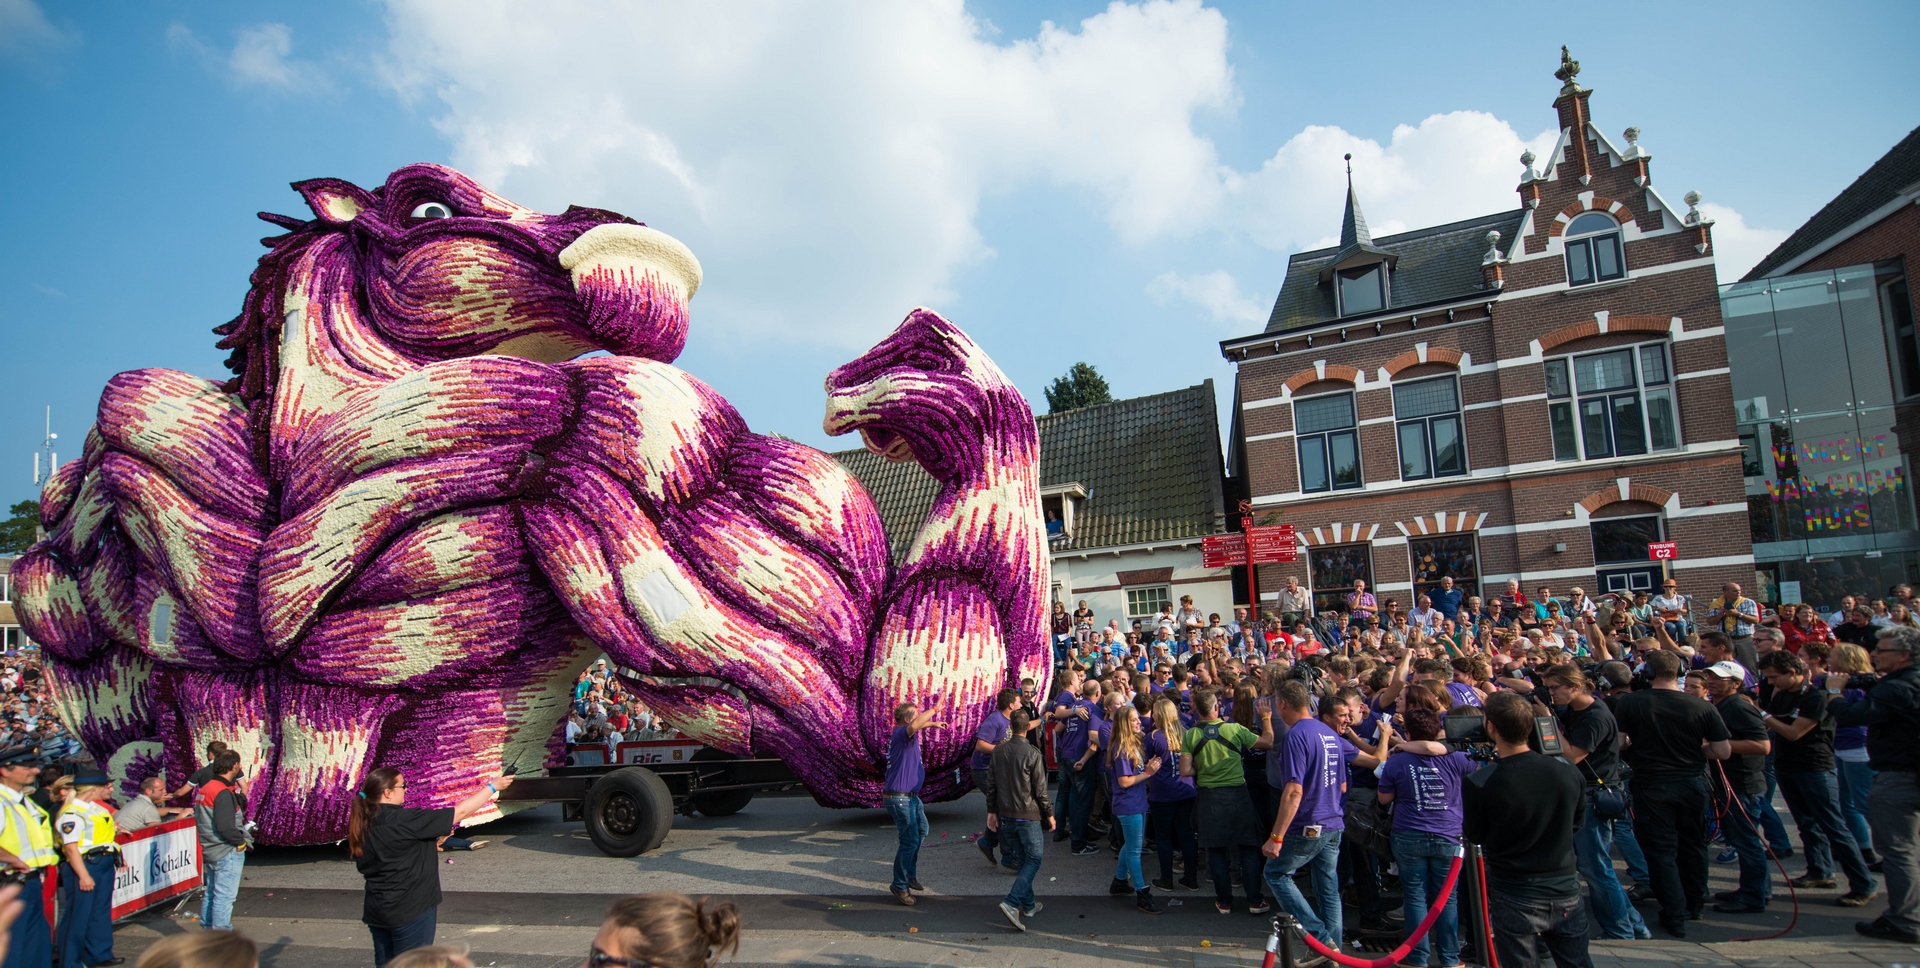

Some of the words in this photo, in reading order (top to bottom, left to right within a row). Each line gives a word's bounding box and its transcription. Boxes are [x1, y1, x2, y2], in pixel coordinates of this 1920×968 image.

[1770, 434, 1887, 468] VINCENT
[1764, 475, 1818, 502] VAN
[1828, 467, 1903, 496] GOGH
[1805, 504, 1871, 531] HUIS
[1649, 542, 1676, 550] TRIBUNE
[1656, 548, 1671, 558] C2
[154, 849, 192, 877] Schalk
